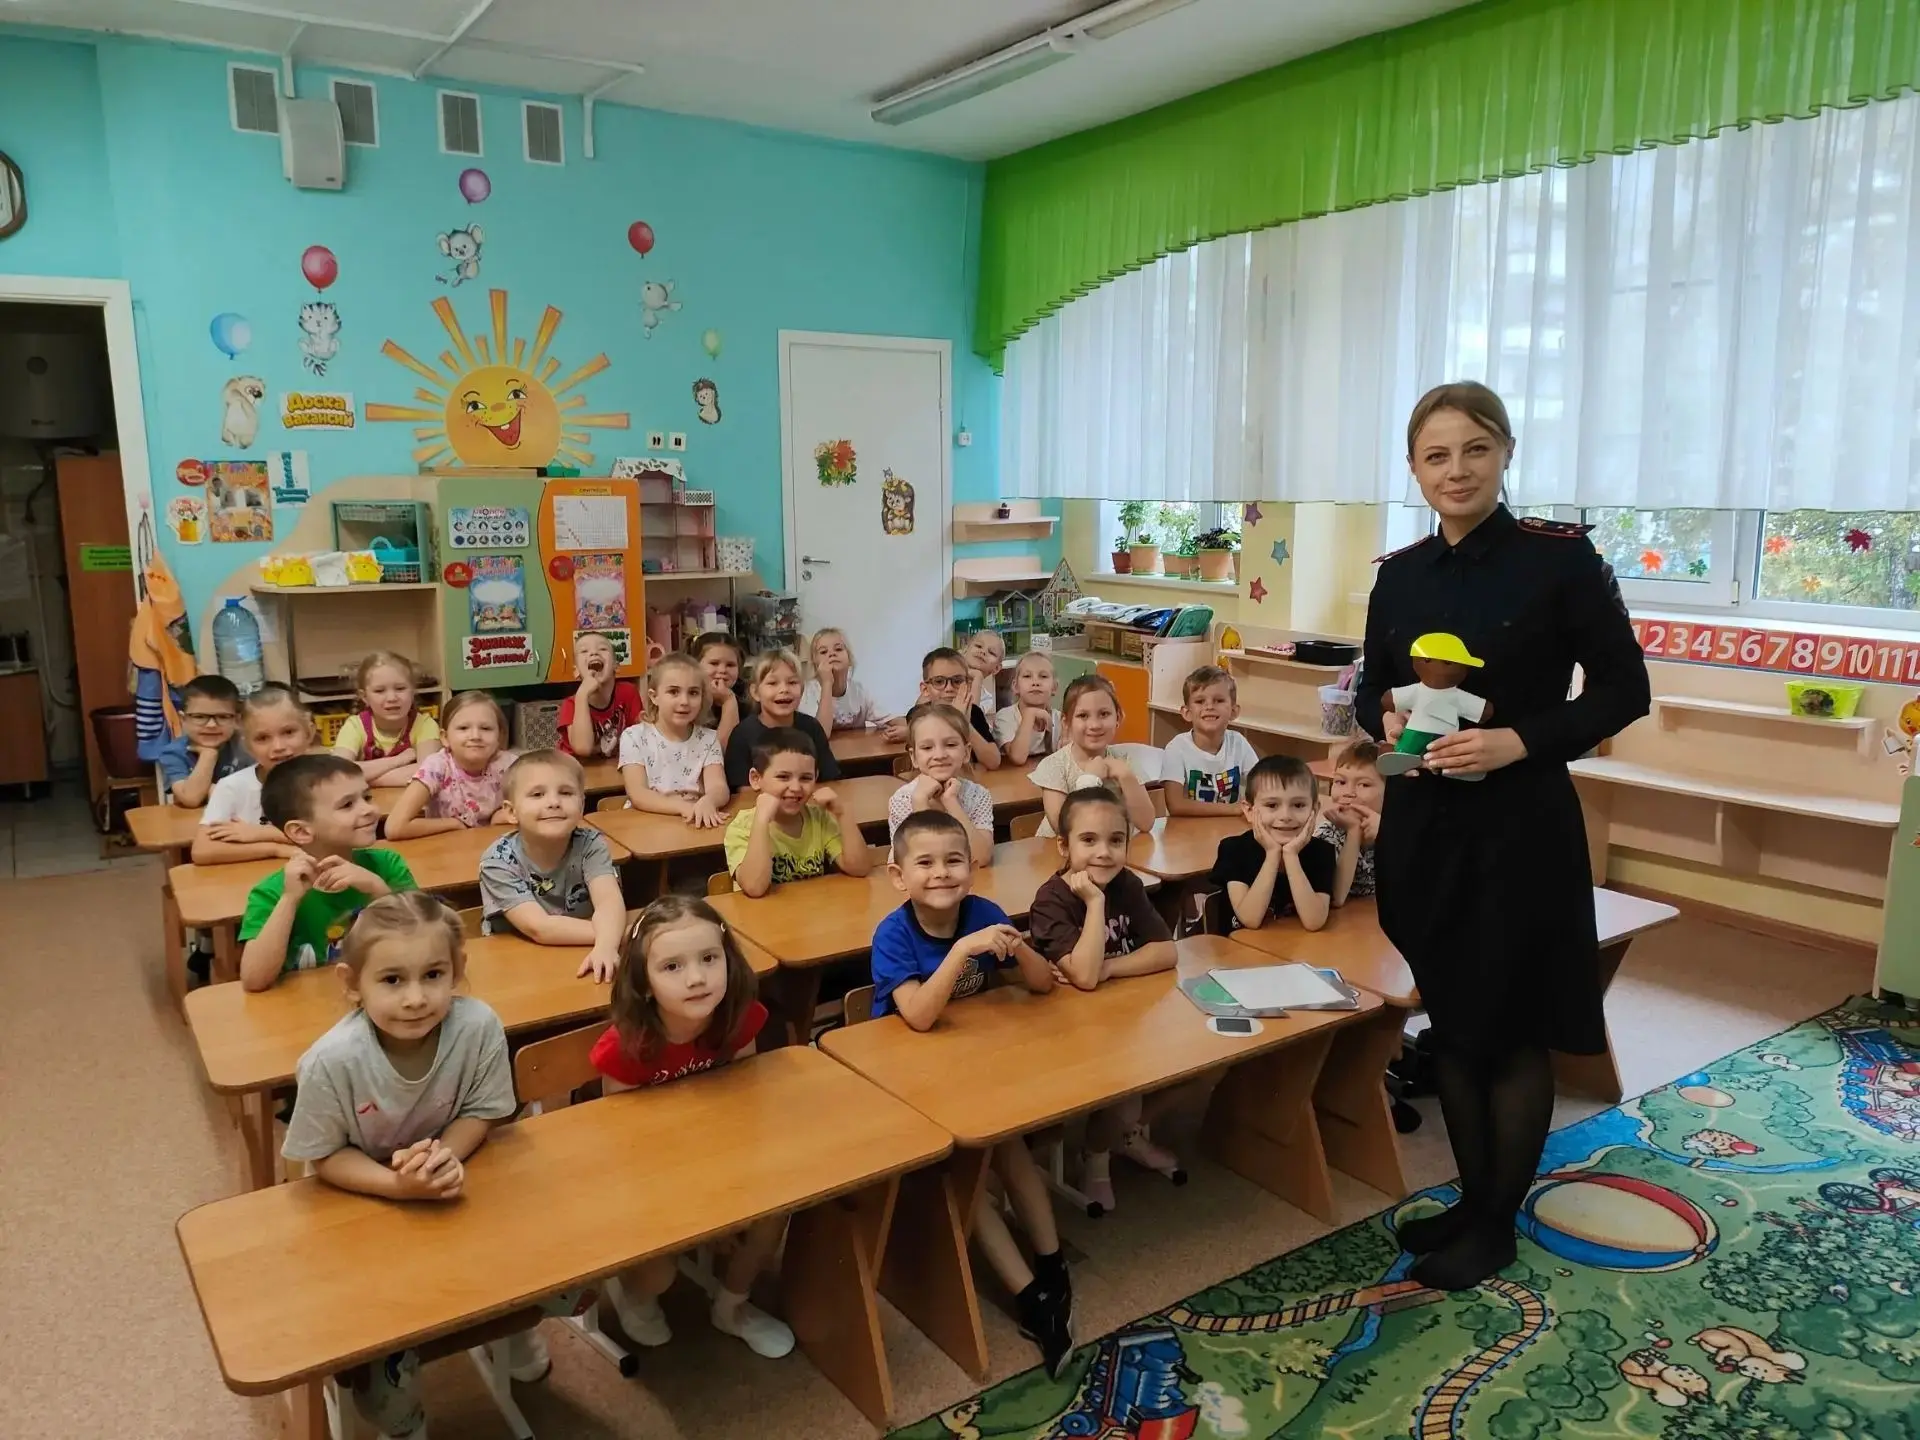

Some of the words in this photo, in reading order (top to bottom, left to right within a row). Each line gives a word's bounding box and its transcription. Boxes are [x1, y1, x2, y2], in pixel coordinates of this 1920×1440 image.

[287, 393, 346, 412] Доска
[1646, 626, 1666, 653] 2
[1668, 628, 1688, 655] 3
[1691, 631, 1712, 658] 4
[1716, 632, 1737, 660] 5
[1740, 634, 1762, 663] 6
[1766, 637, 1789, 665] 7
[1791, 639, 1815, 669] 8
[1821, 642, 1843, 671] 9
[1848, 644, 1873, 674] 10
[1878, 647, 1903, 678] 11
[1907, 650, 1920, 680] 1
